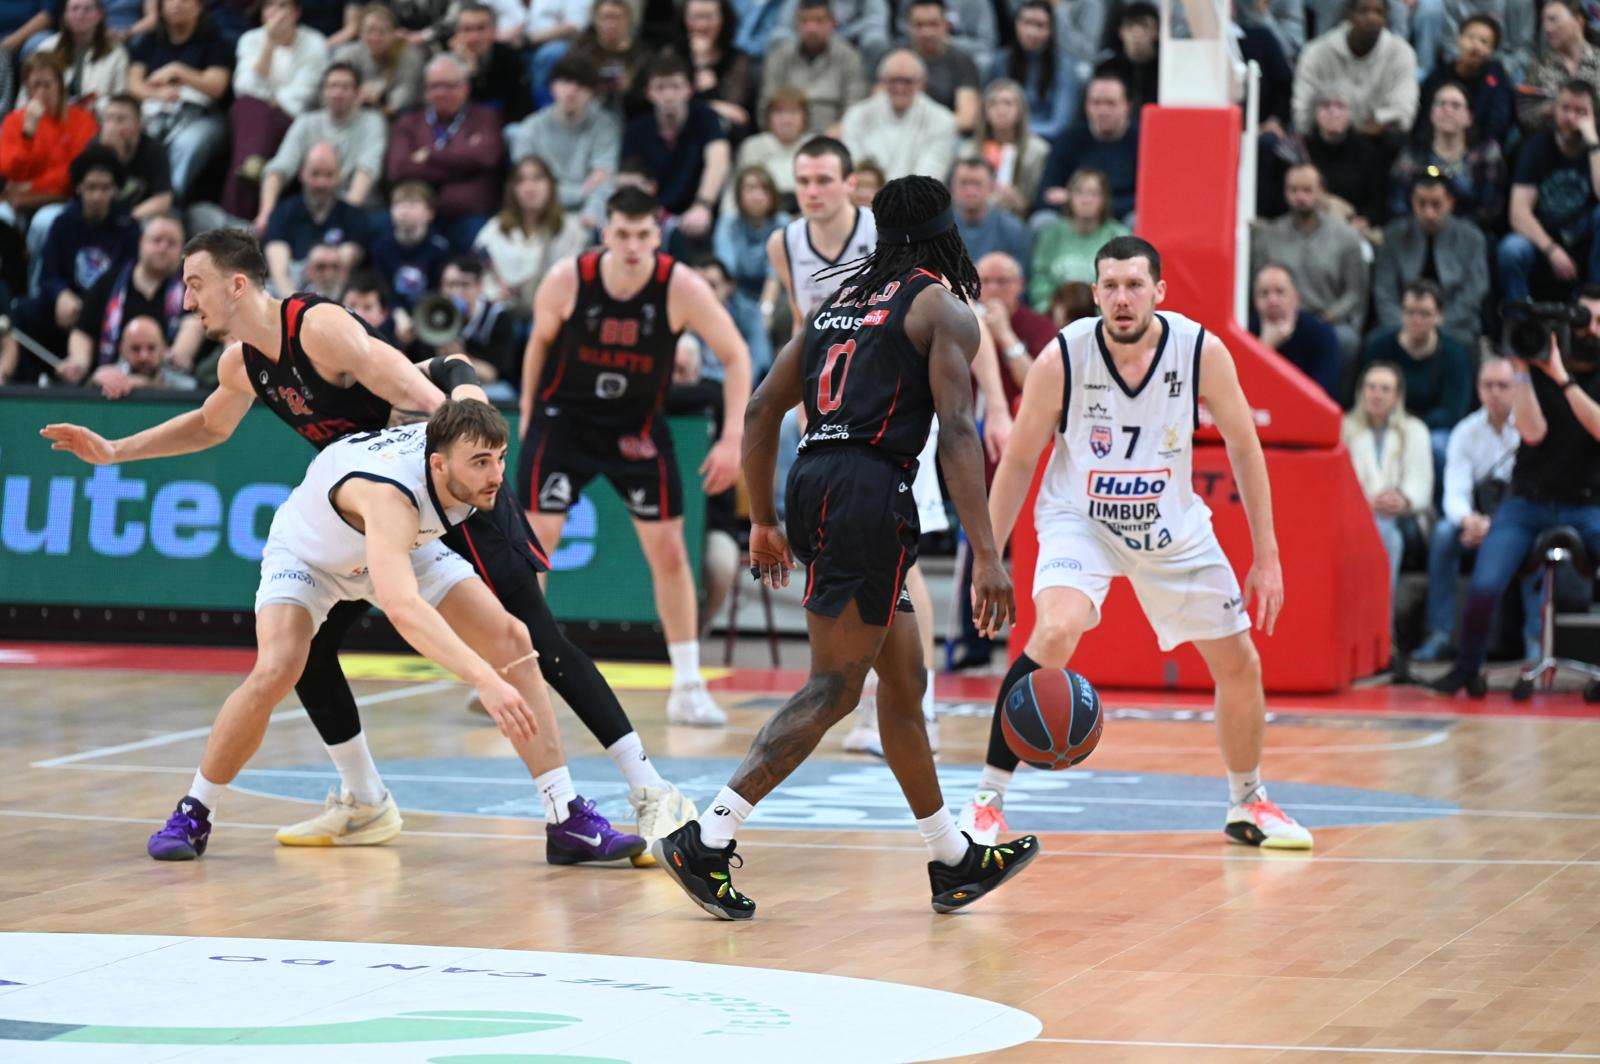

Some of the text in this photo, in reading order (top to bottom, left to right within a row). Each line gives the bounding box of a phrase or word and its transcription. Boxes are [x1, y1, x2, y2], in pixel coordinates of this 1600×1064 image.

[814, 311, 864, 330] Circus
[817, 338, 857, 415] 0
[1122, 426, 1141, 459] 7
[1094, 477, 1165, 496] Hubo
[207, 955, 336, 966] DO
